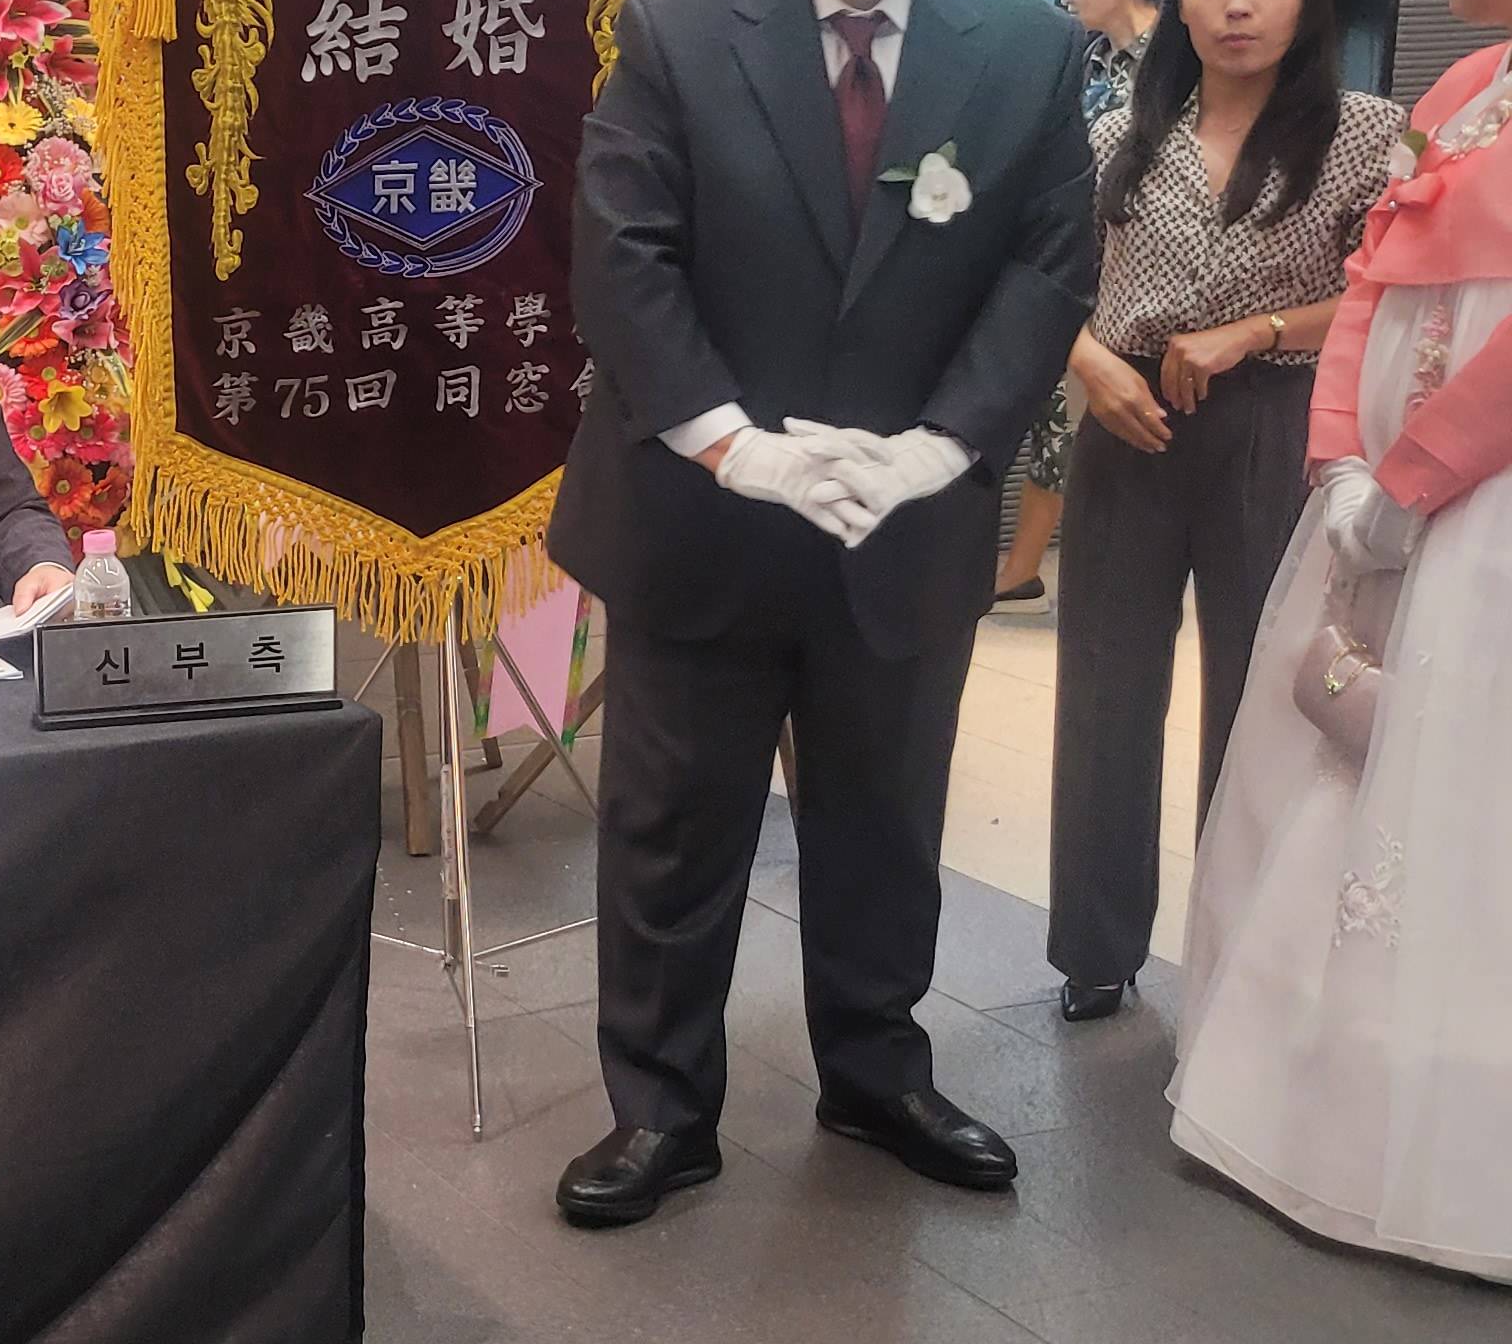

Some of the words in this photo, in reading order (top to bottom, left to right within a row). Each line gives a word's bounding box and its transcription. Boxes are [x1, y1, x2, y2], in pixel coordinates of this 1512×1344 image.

[371, 159, 478, 215] 京畿
[212, 292, 586, 359] 京畿高等學
[95, 635, 286, 686] 신부측
